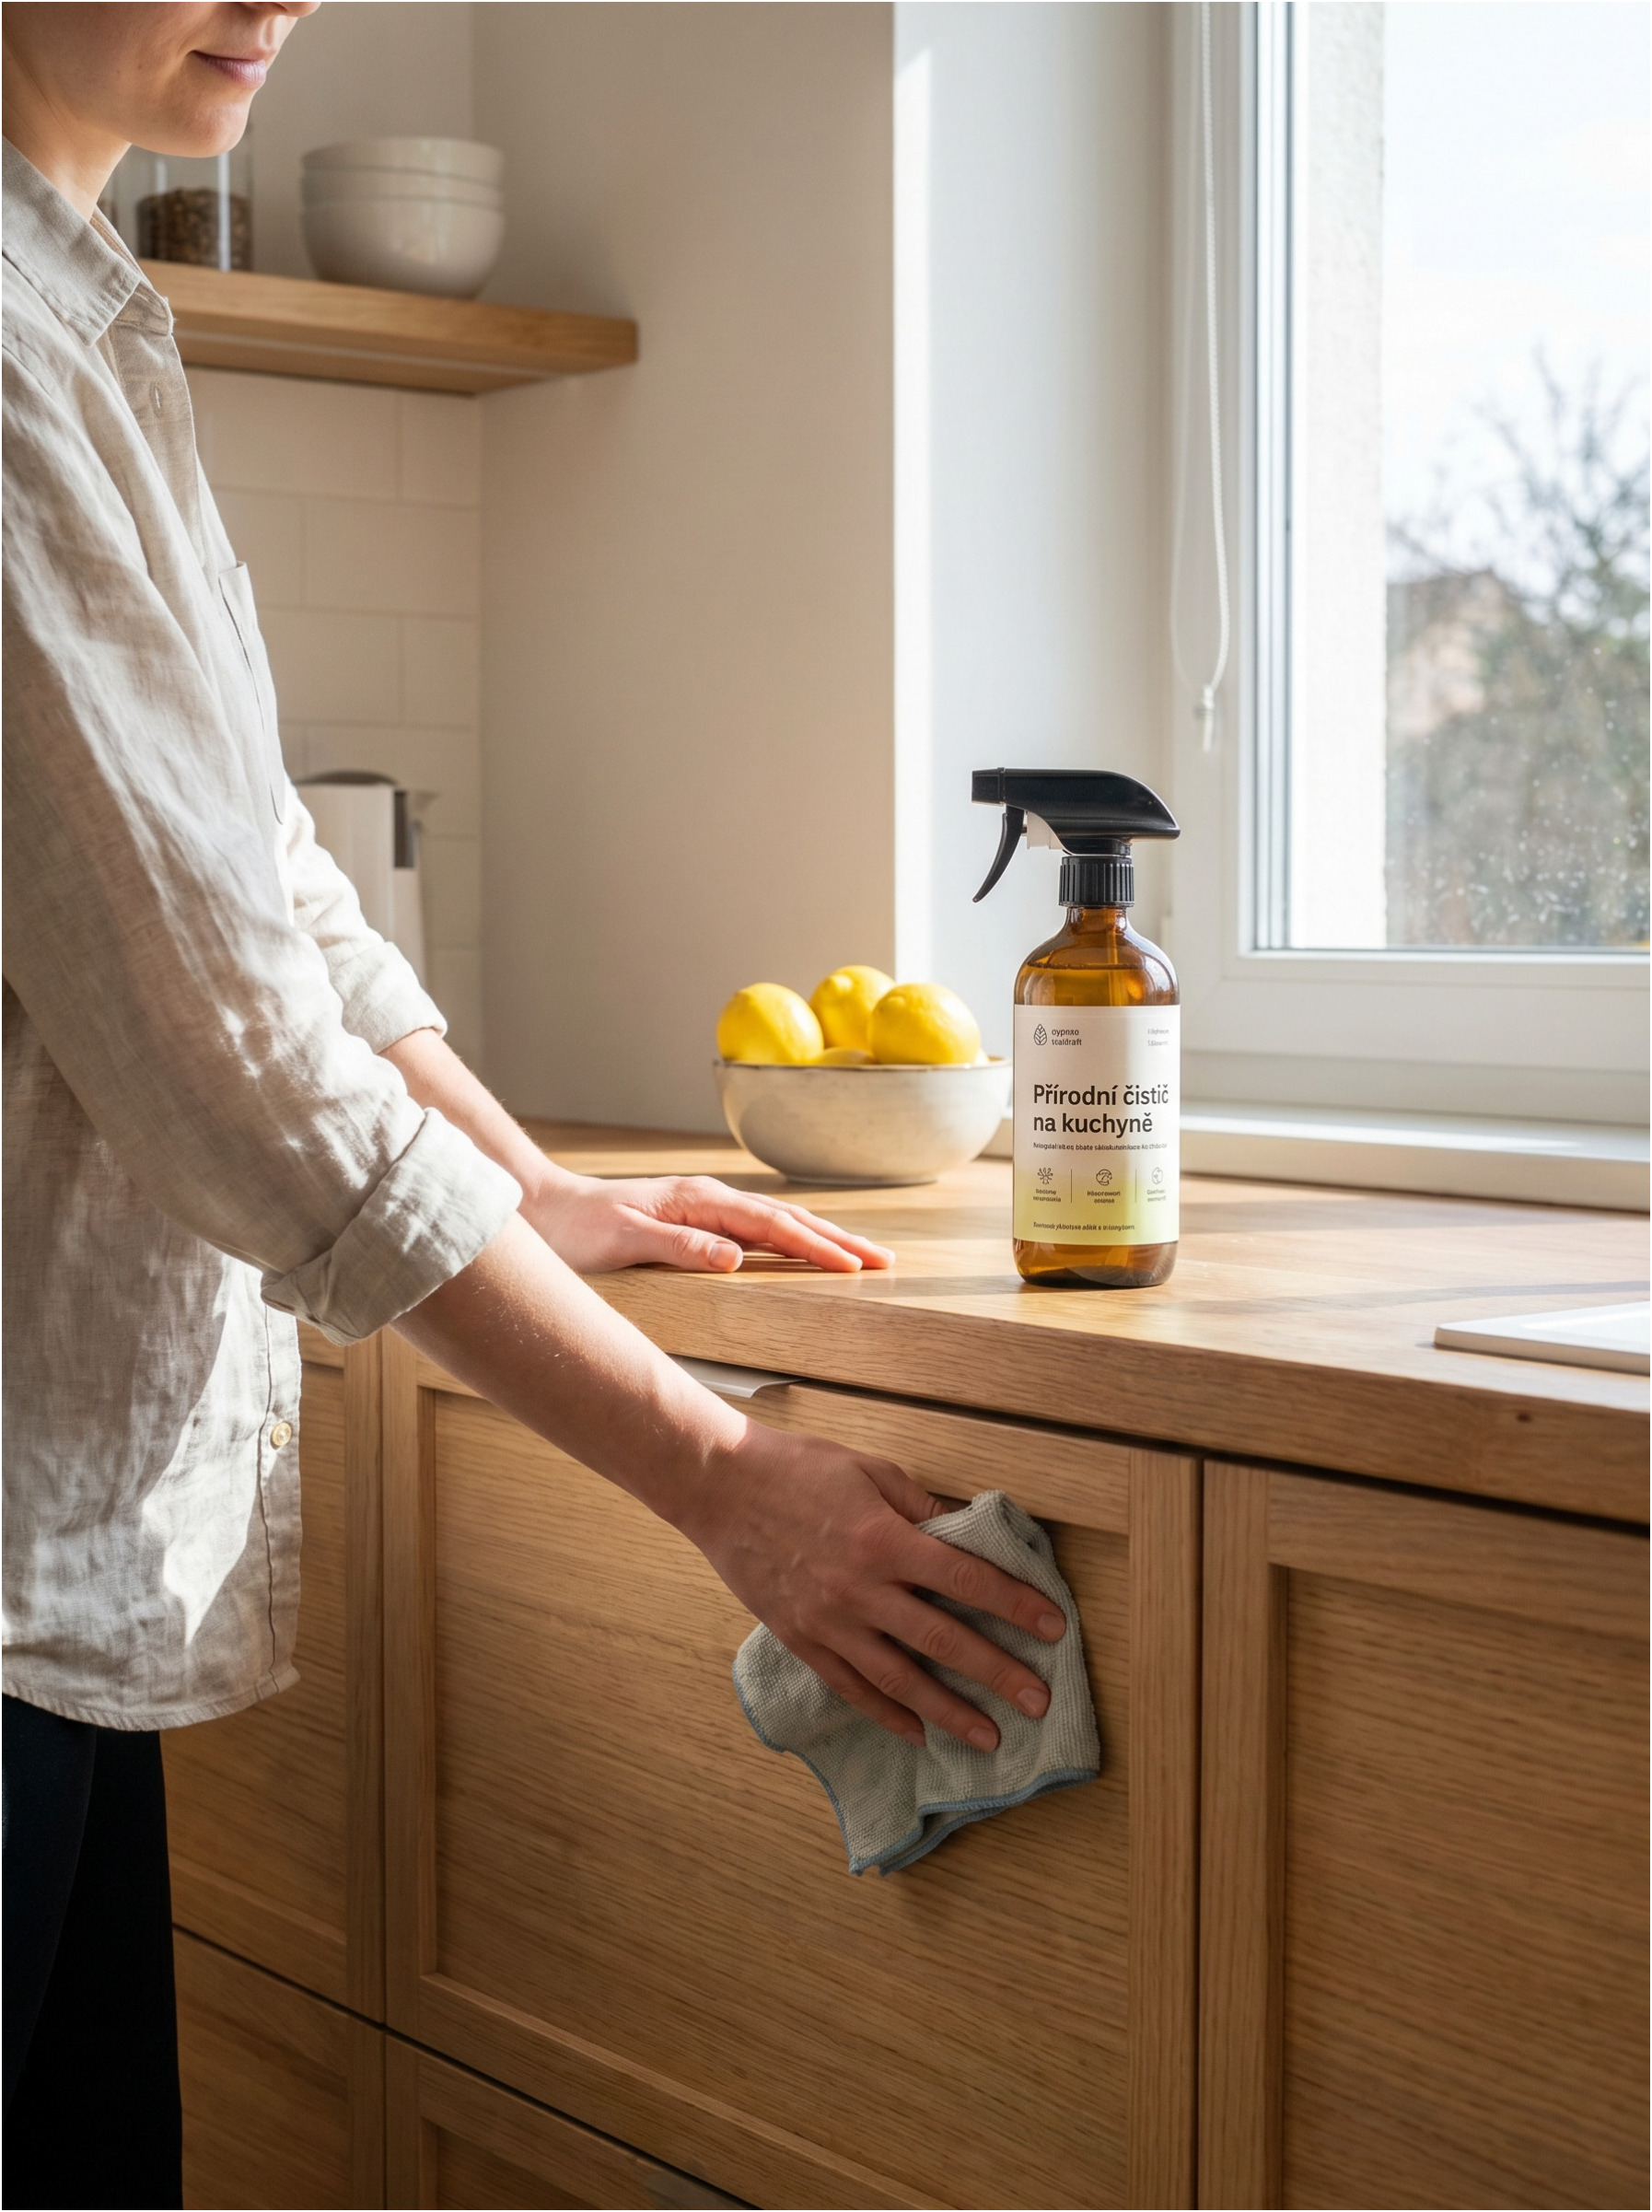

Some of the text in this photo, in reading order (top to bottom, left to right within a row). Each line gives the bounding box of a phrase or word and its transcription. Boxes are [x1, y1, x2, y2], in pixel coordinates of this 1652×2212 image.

[1033, 1084, 1169, 1105] Přírodní čistič
[1033, 1112, 1152, 1138] na kuchyně
